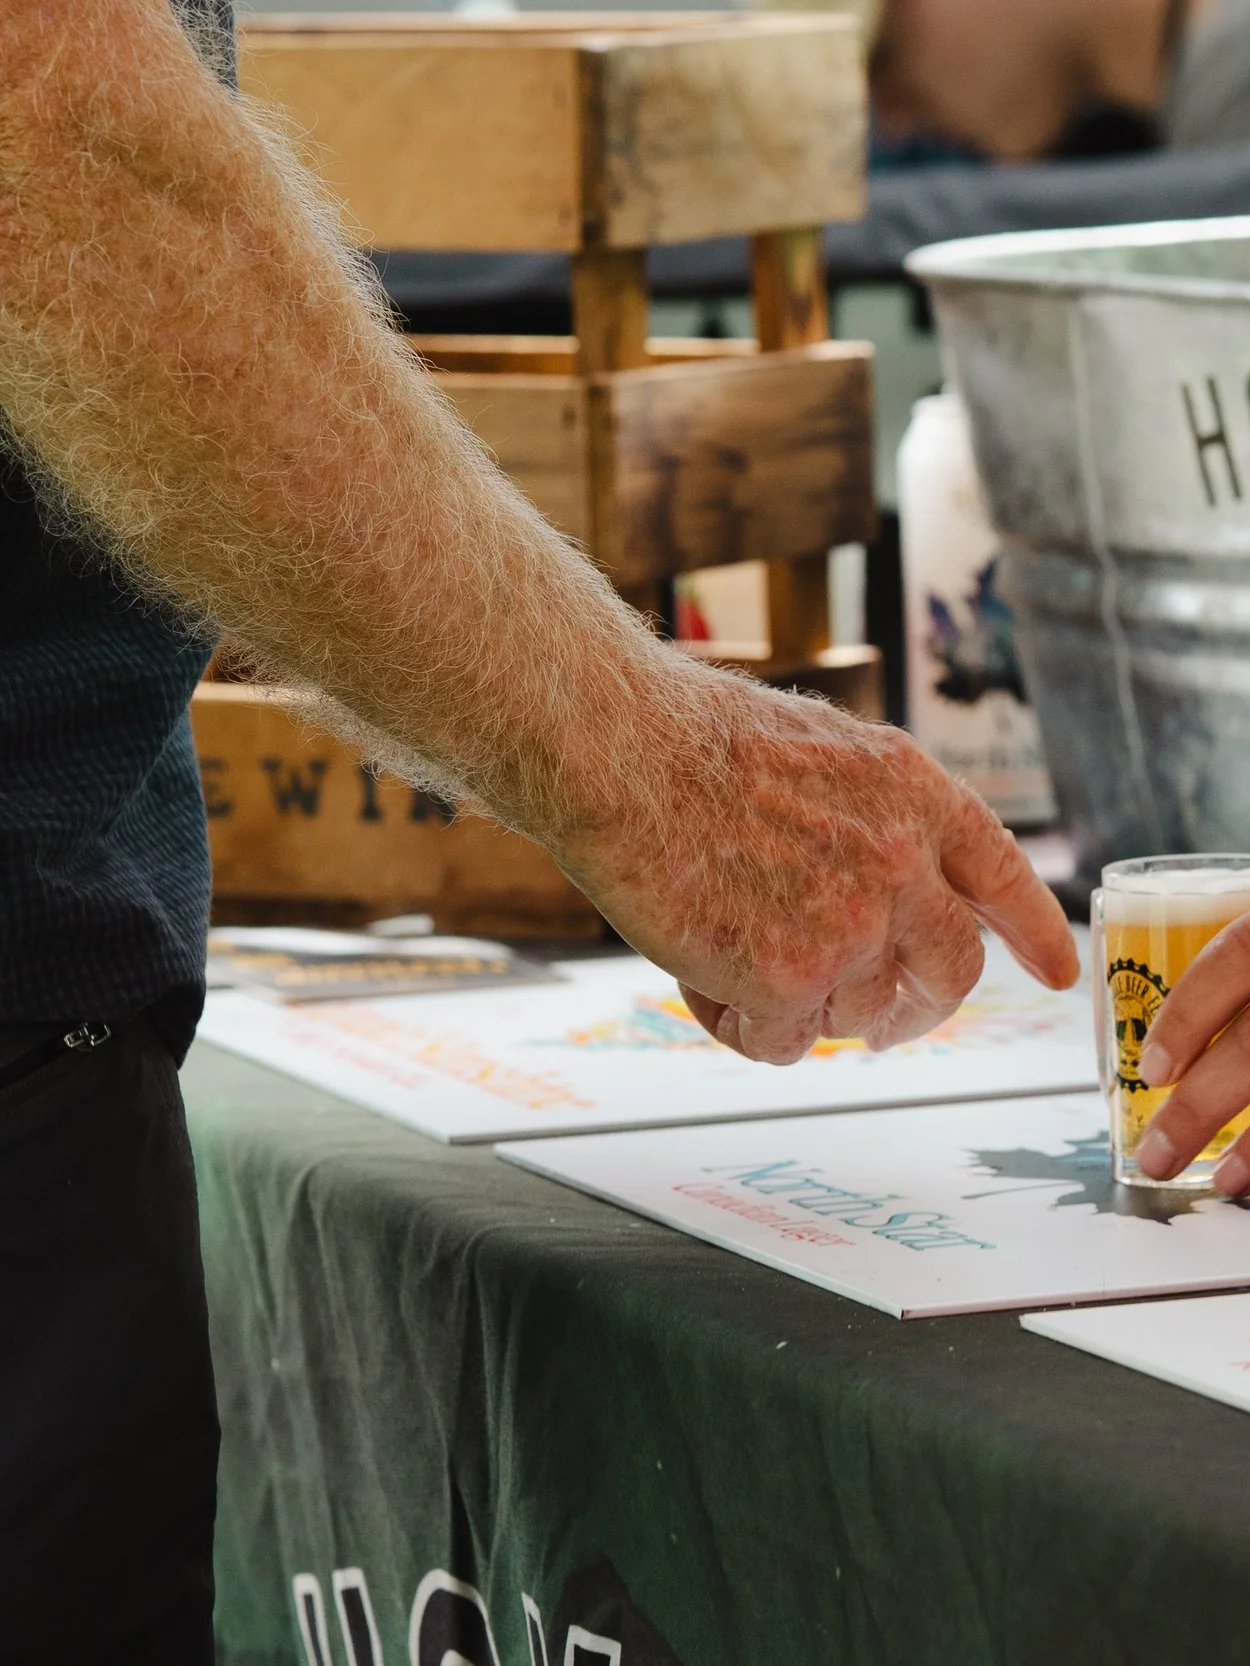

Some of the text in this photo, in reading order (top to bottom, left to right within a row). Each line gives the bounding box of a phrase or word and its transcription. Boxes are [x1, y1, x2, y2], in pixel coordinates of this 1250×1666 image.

[1125, 974, 1150, 1000] BEER
[700, 1159, 997, 1251] North Star
